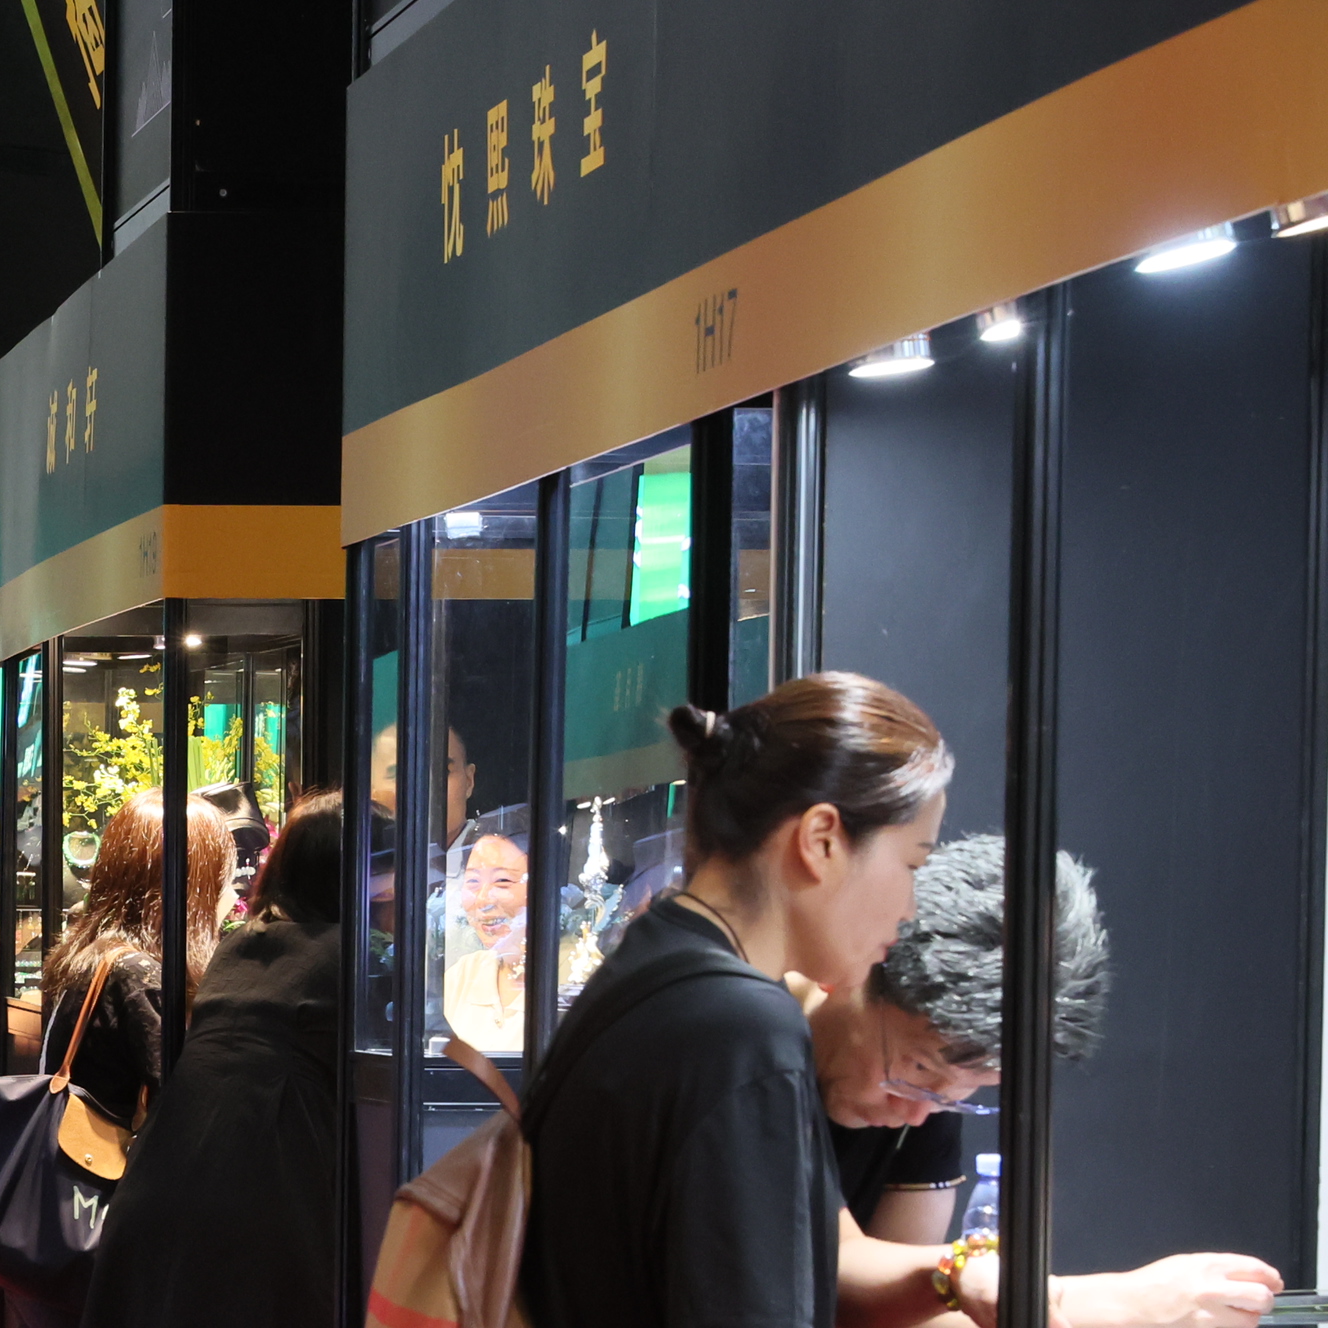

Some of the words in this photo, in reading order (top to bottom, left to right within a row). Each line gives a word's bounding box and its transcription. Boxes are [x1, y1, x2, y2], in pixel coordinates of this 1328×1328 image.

[441, 28, 606, 264] 忱熙珠宝
[695, 288, 737, 374] 1H17
